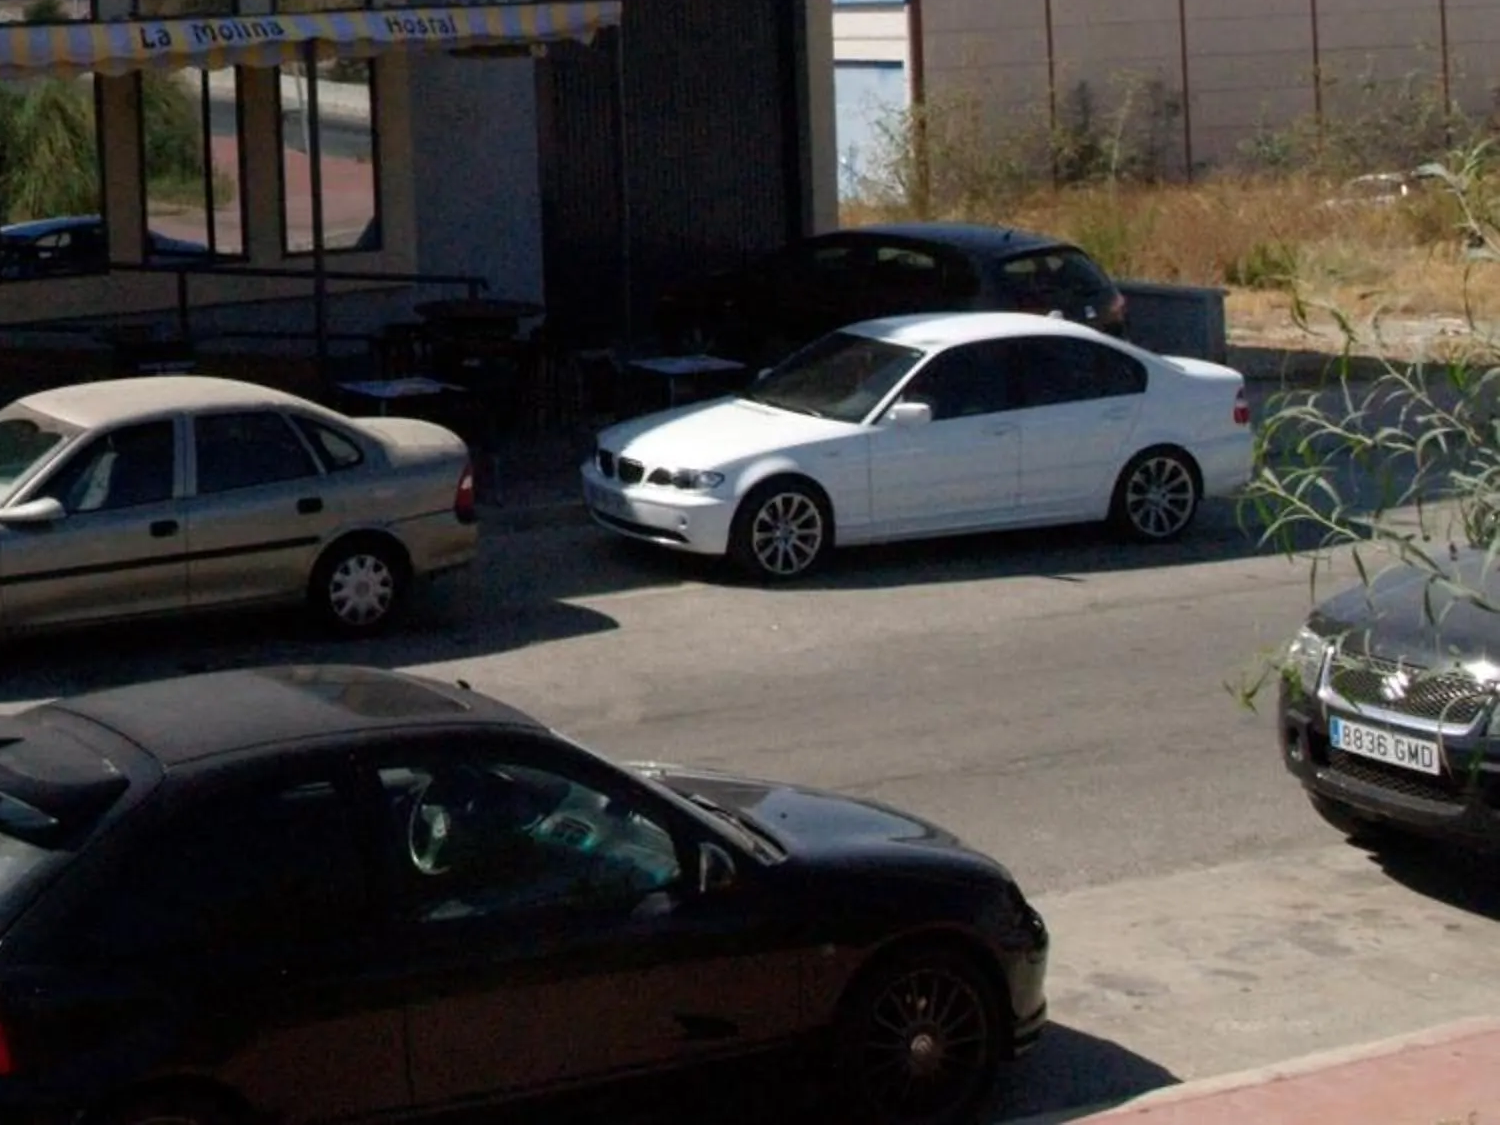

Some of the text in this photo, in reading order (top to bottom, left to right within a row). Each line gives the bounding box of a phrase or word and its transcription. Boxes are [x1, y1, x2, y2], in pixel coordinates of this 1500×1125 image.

[138, 13, 458, 50] La Molina Hostal
[1394, 738, 1434, 769] GMD
